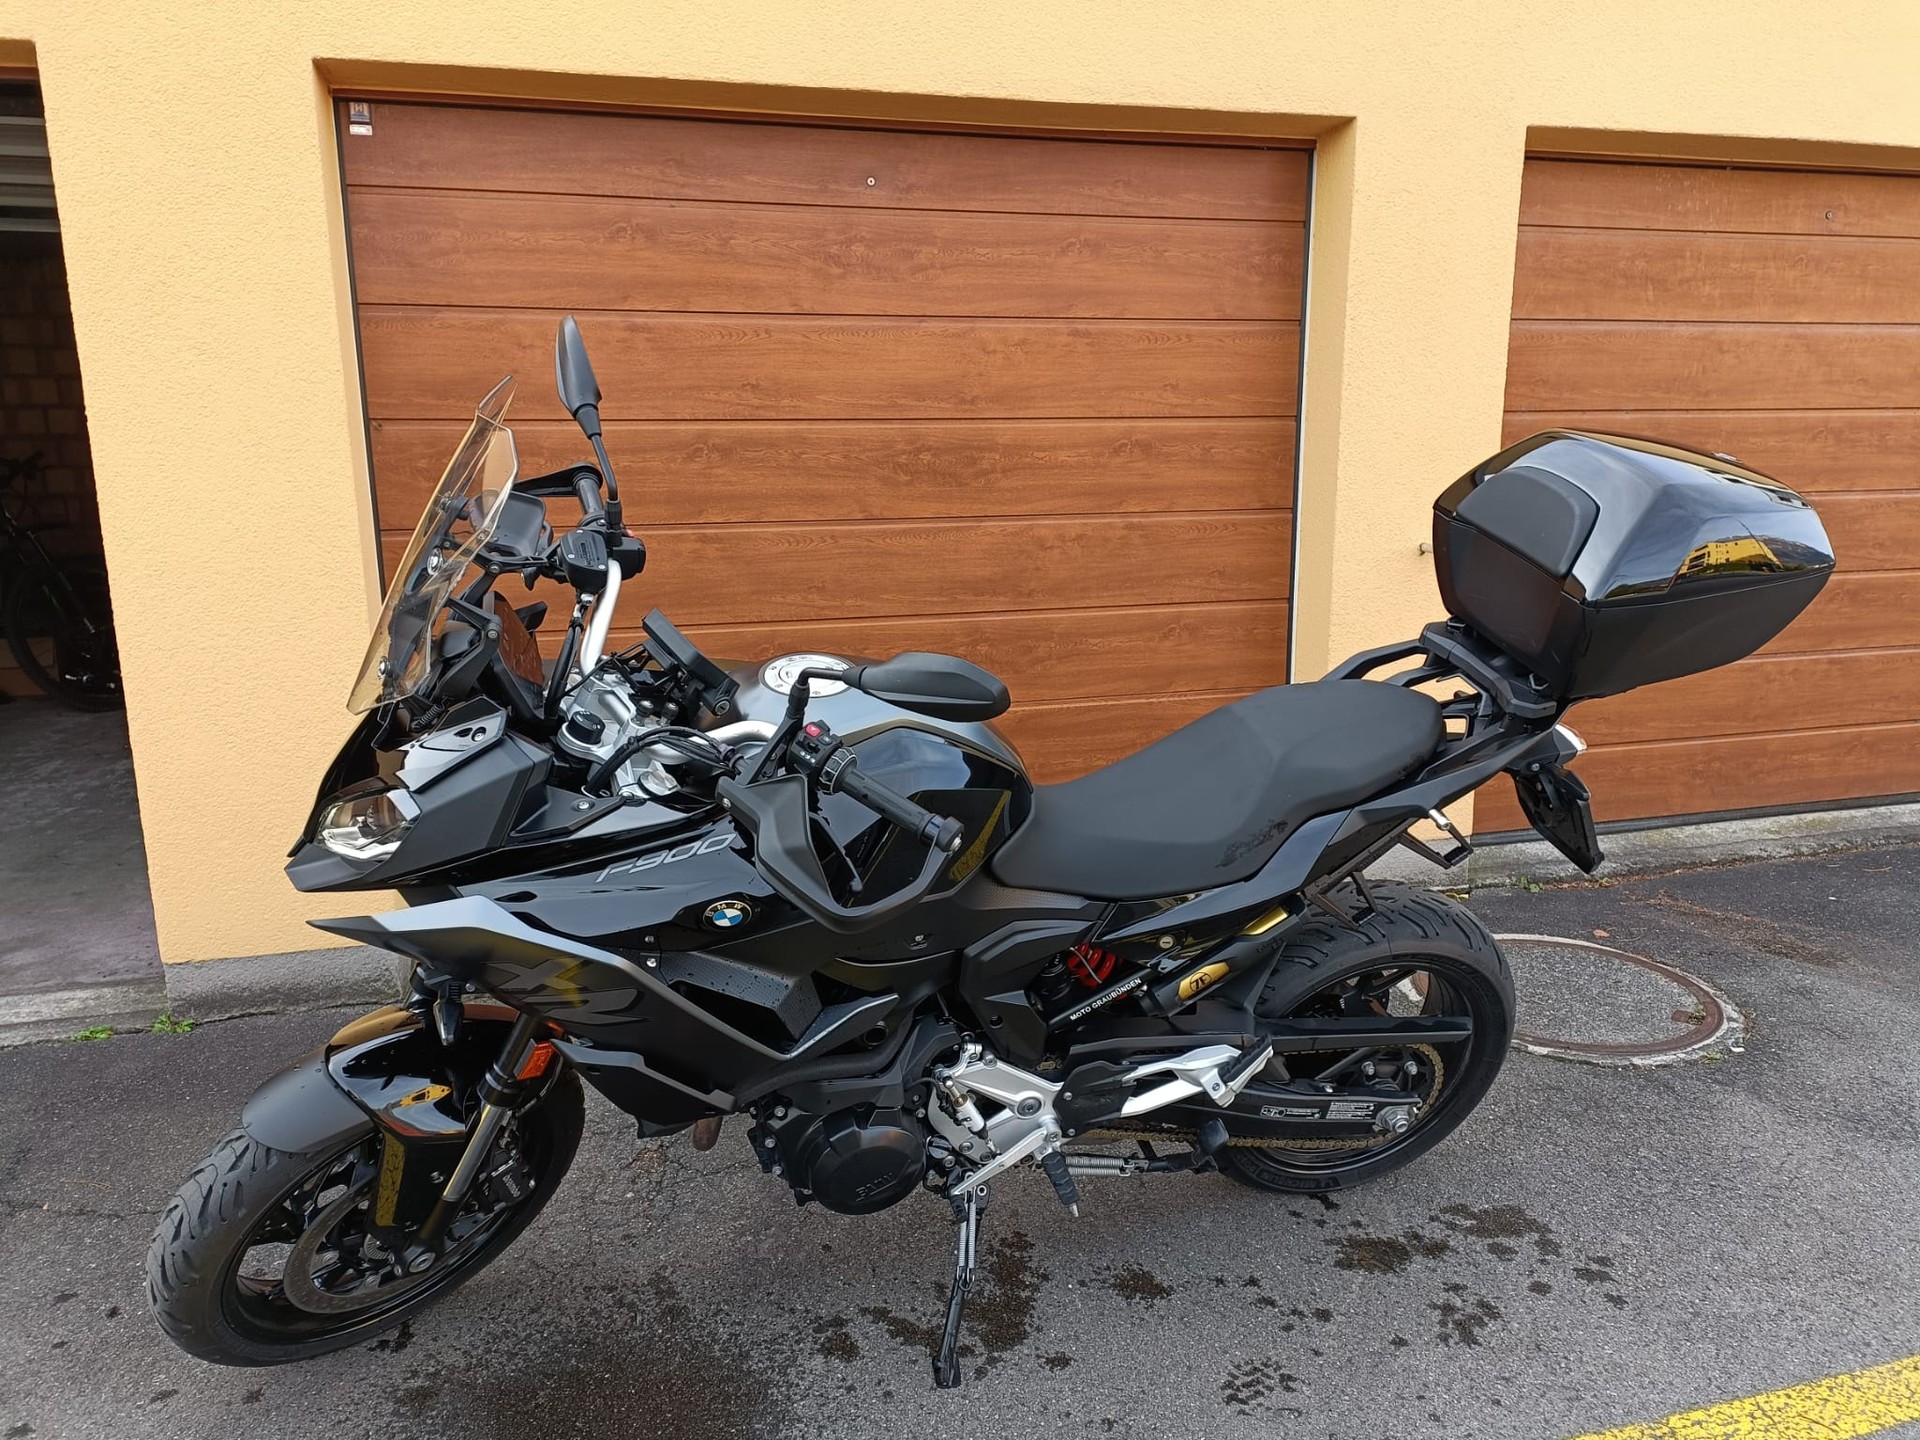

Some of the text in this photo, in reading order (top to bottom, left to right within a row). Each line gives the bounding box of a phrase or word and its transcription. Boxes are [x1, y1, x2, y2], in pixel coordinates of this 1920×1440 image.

[595, 833, 736, 883] F900
[705, 902, 744, 917] BMW
[1069, 977, 1142, 1021] MOTO GRAUBÜNDEN
